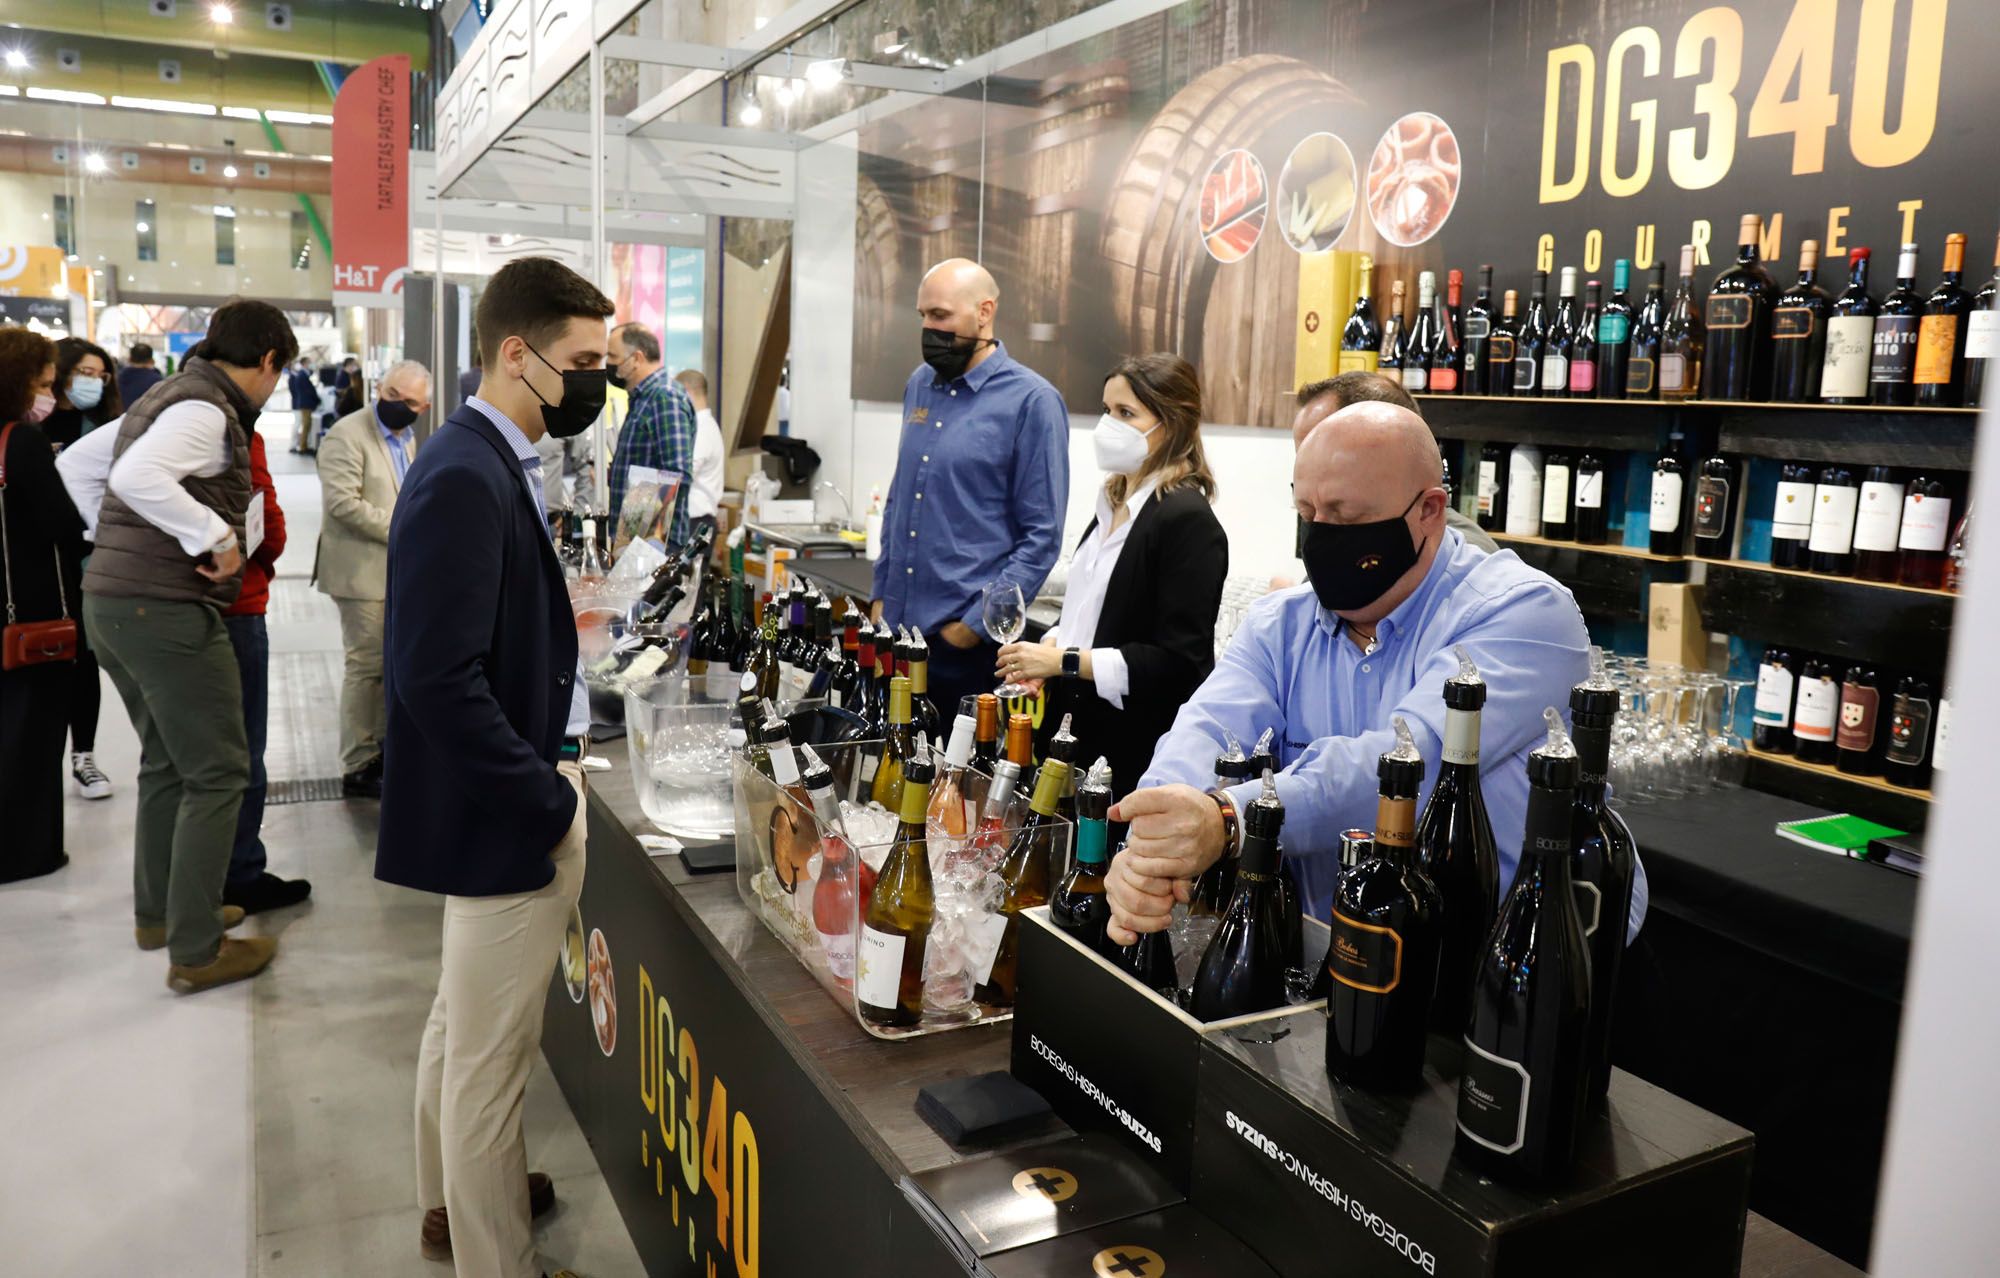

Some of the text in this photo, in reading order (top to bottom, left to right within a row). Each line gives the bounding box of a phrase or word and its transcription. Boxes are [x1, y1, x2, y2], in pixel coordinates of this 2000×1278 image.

[377, 66, 396, 211] TARTALETAS PASTRY CHEF
[1538, 0, 1948, 205] DG340
[333, 263, 380, 288] H&T
[1030, 1033, 1075, 1082] BODEGAS
[639, 963, 760, 1278] DG340
[1350, 1199, 1436, 1276] BODEGAS
